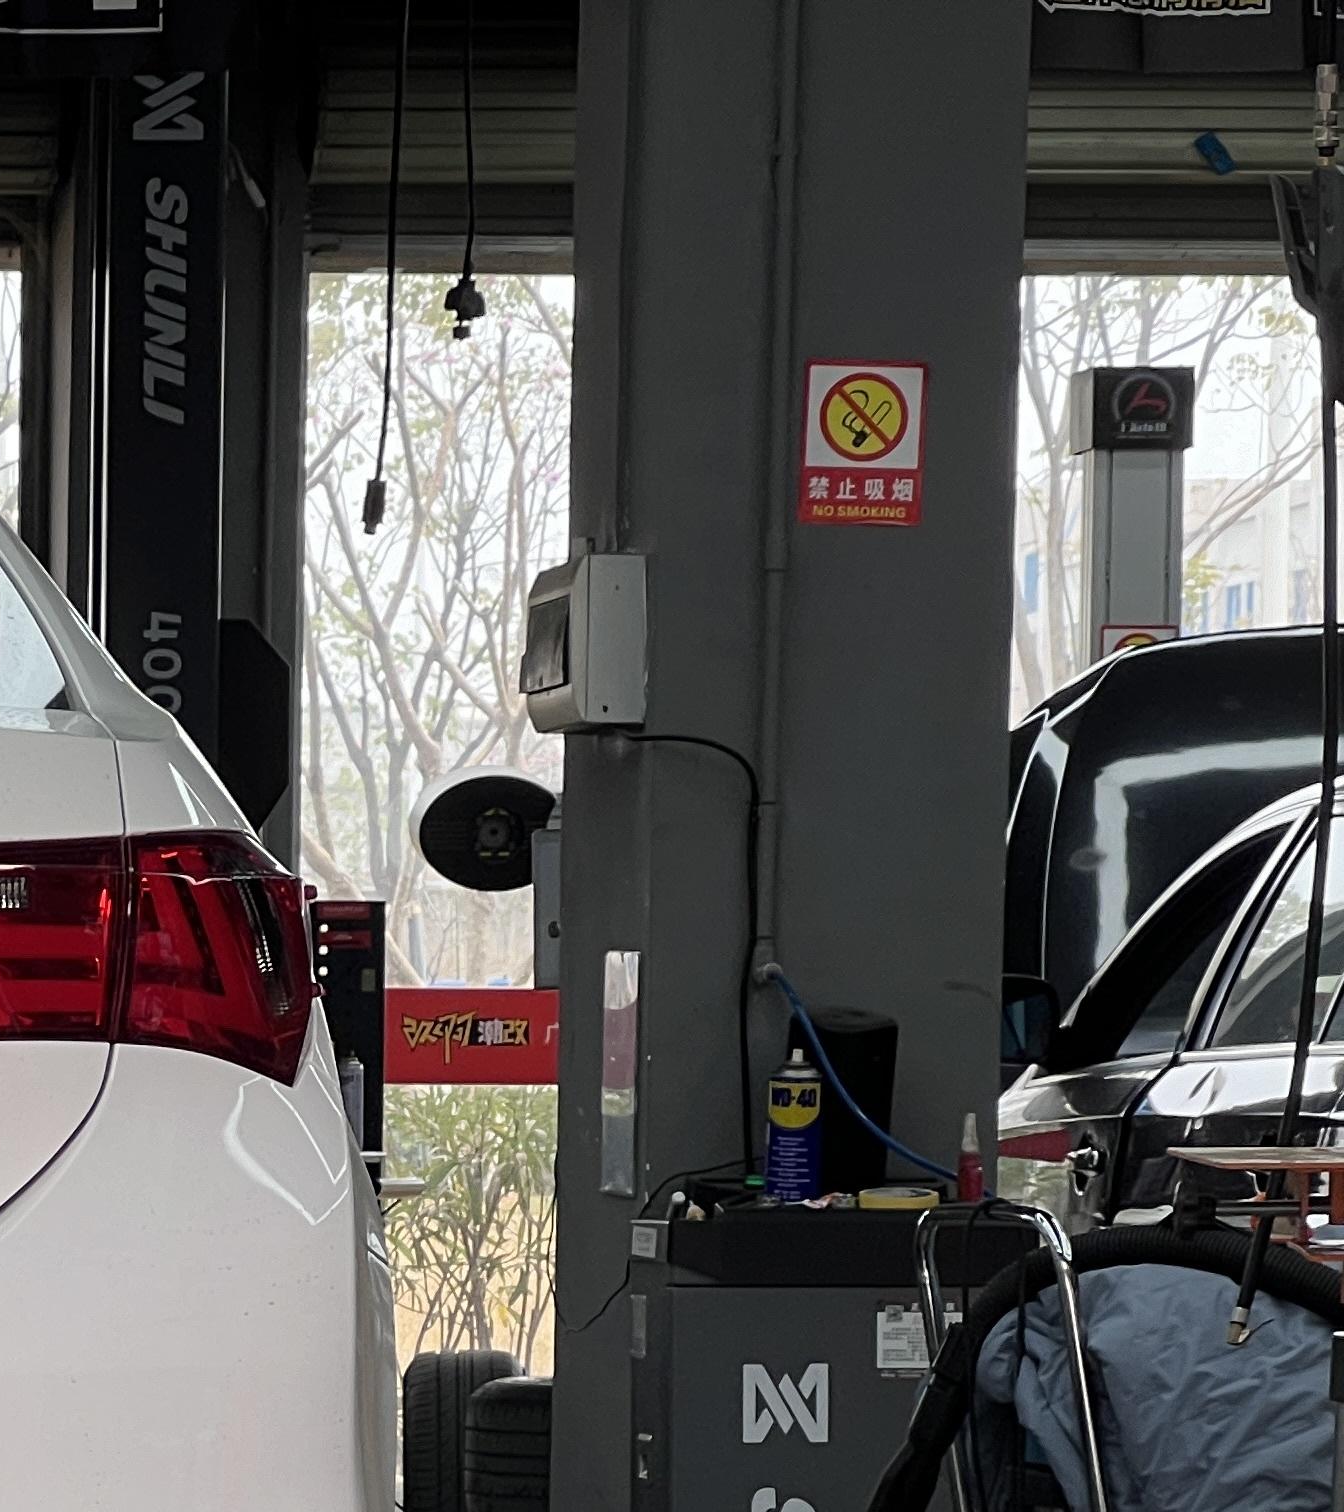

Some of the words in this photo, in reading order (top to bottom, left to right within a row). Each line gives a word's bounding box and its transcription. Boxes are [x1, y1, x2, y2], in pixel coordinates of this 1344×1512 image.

[143, 177, 189, 425] SHUNLI
[808, 476, 913, 501] 禁止吸烟
[813, 505, 834, 516] NO
[837, 506, 906, 518] SMOKING
